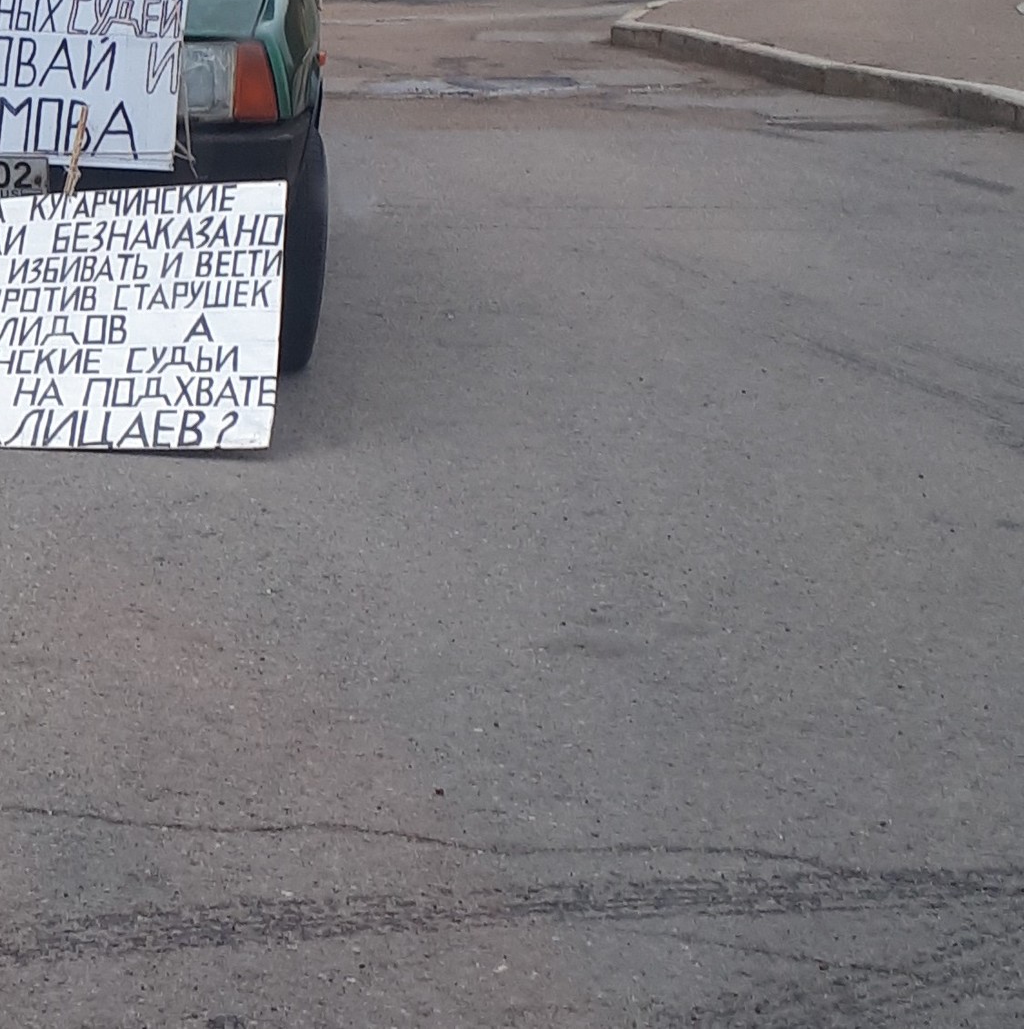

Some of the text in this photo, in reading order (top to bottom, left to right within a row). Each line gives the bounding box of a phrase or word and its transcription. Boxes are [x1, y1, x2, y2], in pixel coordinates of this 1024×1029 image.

[146, 40, 182, 94] И
[51, 214, 284, 253] БЕЗНАКАЗАНО
[8, 252, 148, 284] ИЗБИВАТЬ
[160, 252, 184, 278] И
[195, 250, 283, 278] ВЕСТИ
[113, 279, 273, 312] СТАРУШЕК
[183, 312, 214, 342] А
[126, 345, 239, 374] СУДЬИ
[13, 377, 64, 407] НА
[82, 375, 277, 407] ПОДХВАТЕ
